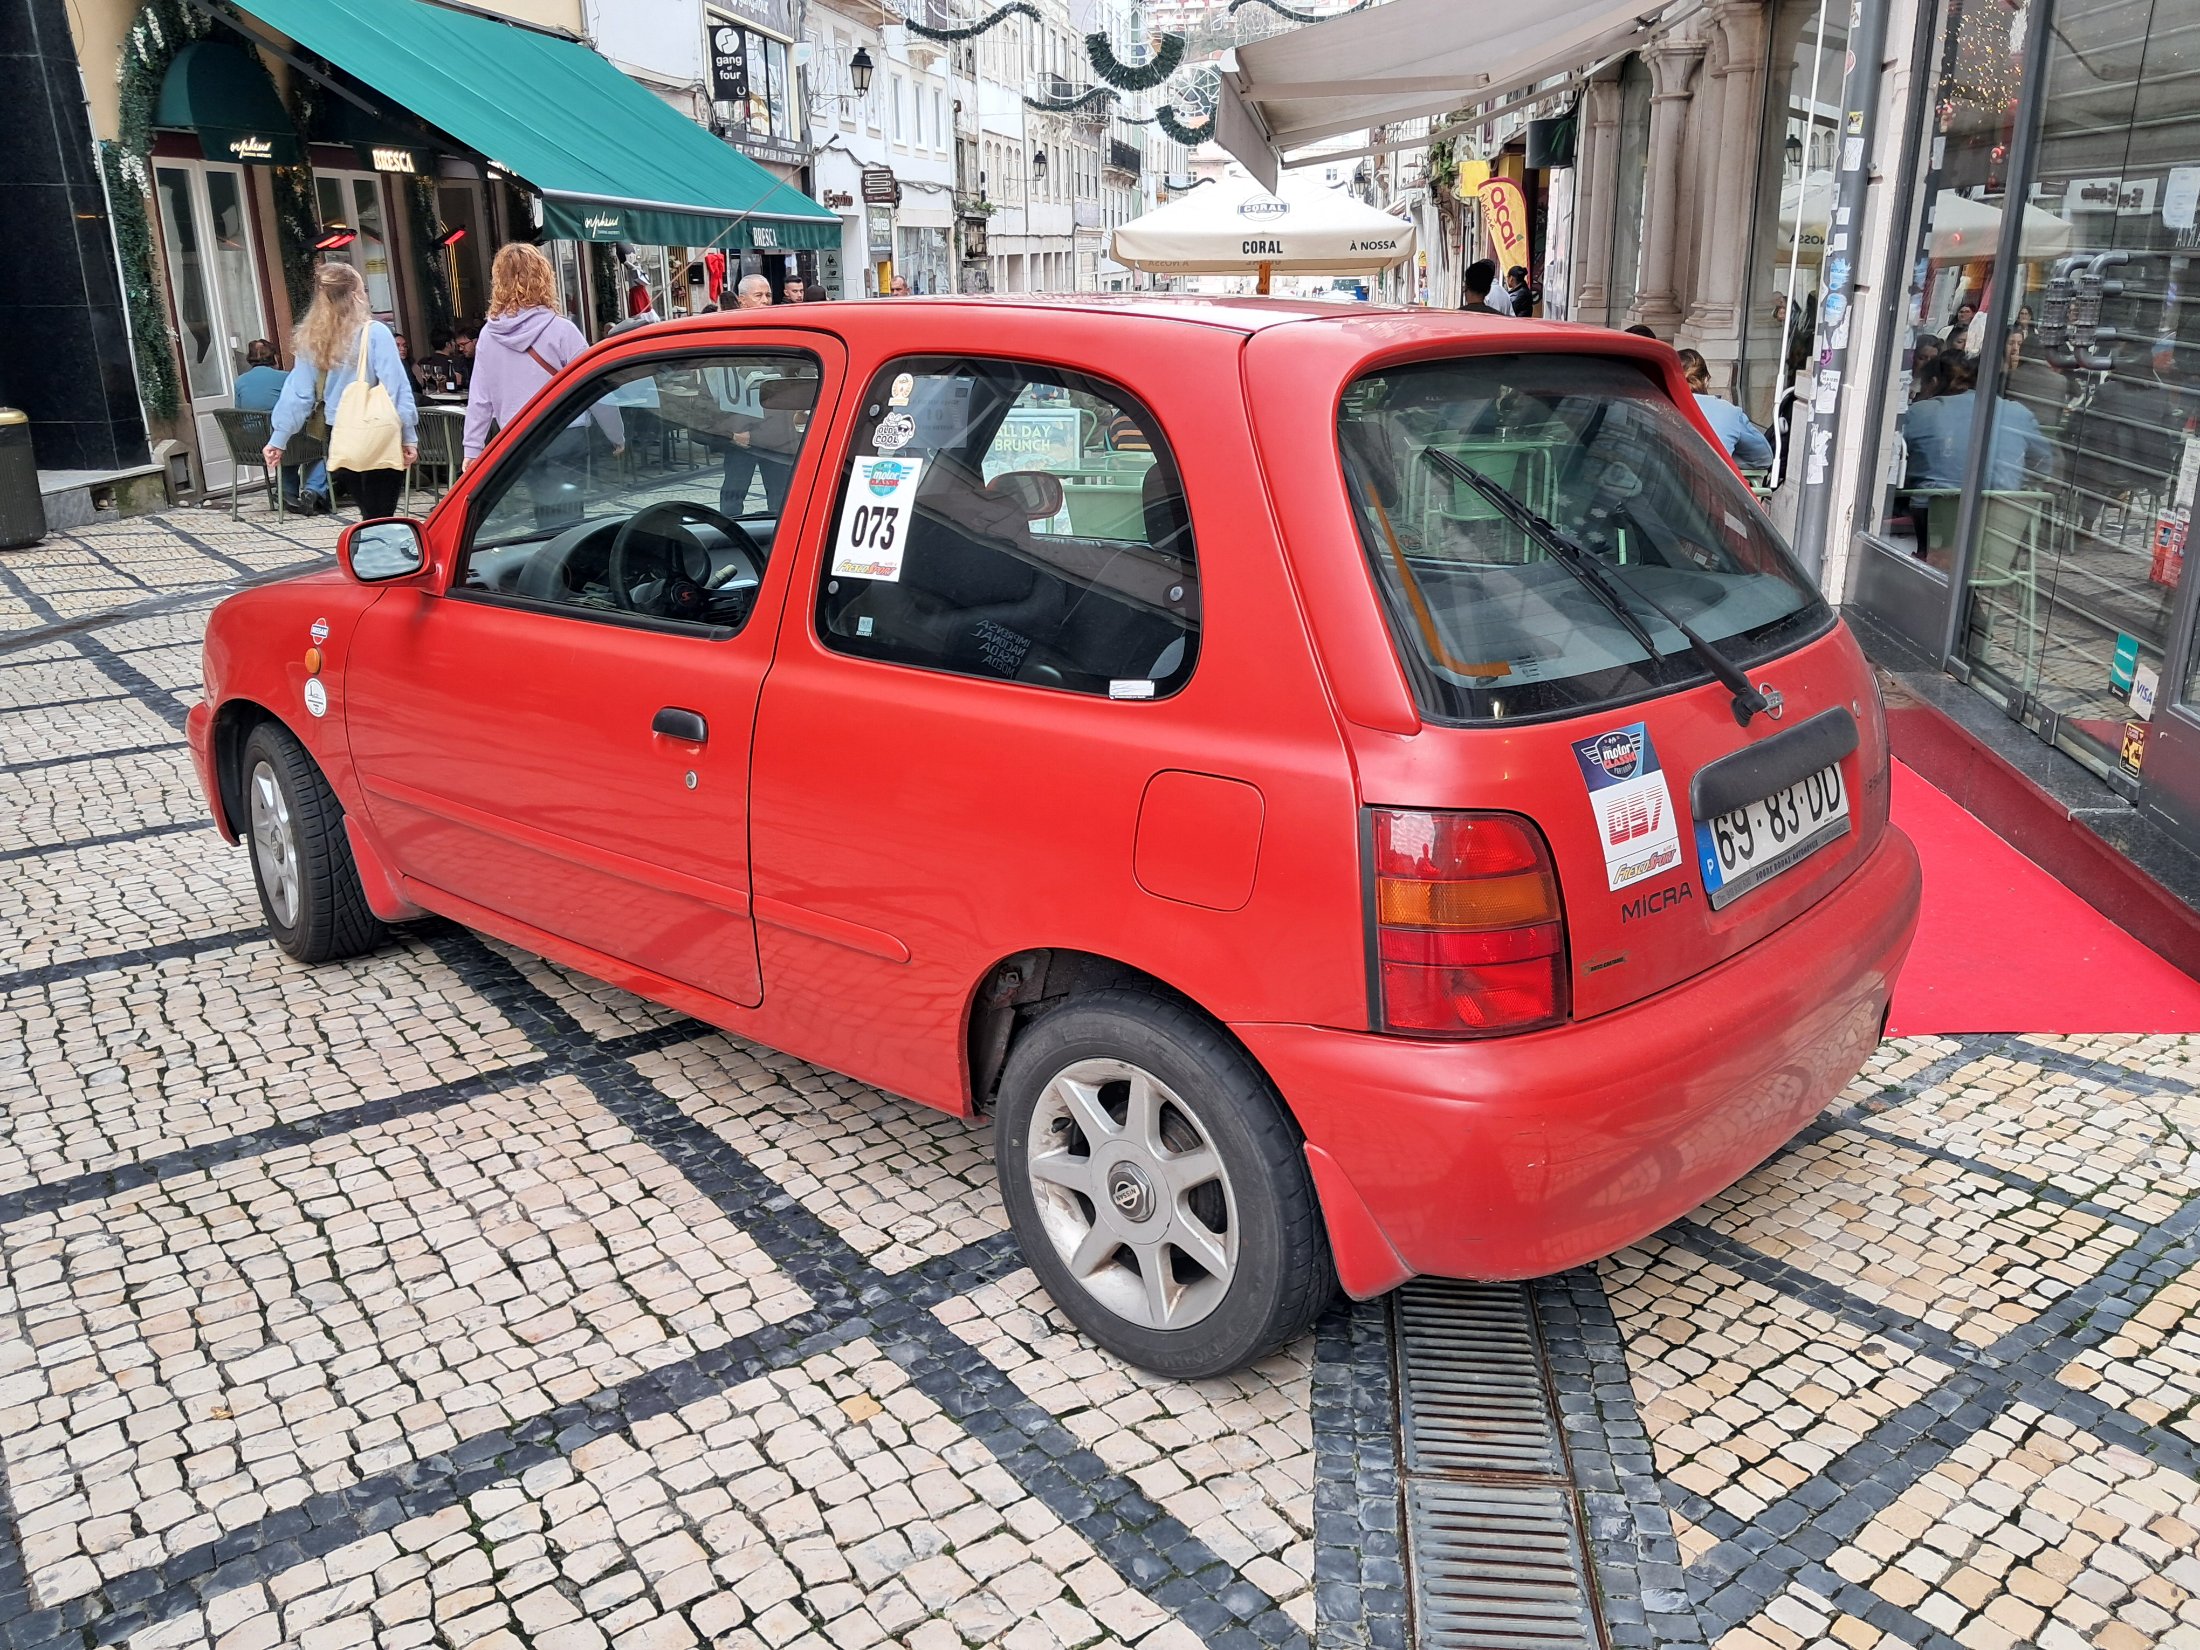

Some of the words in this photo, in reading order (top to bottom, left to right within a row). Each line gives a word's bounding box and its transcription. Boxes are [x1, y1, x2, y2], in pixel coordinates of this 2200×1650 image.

[716, 56, 742, 67] gang
[719, 70, 741, 80] four
[372, 149, 415, 172] BRESCA
[1243, 203, 1284, 213] CORAL
[752, 227, 778, 247] BRESCA
[1242, 240, 1284, 254] CORAL
[1350, 240, 1358, 251] À
[1360, 240, 1397, 251] NOSSA
[878, 426, 894, 434] OLD
[1021, 425, 1051, 438] DAY
[875, 436, 899, 444] COOL
[994, 439, 1050, 452] BRUNCH
[873, 469, 900, 480] motor
[851, 505, 899, 550] 073
[2136, 680, 2153, 703] VISA
[1603, 743, 1632, 760] motor
[1603, 751, 1636, 769] CLASSIC
[1606, 784, 1664, 846] 057
[1706, 858, 1714, 876] P
[1115, 1188, 1137, 1201] NISSAN
